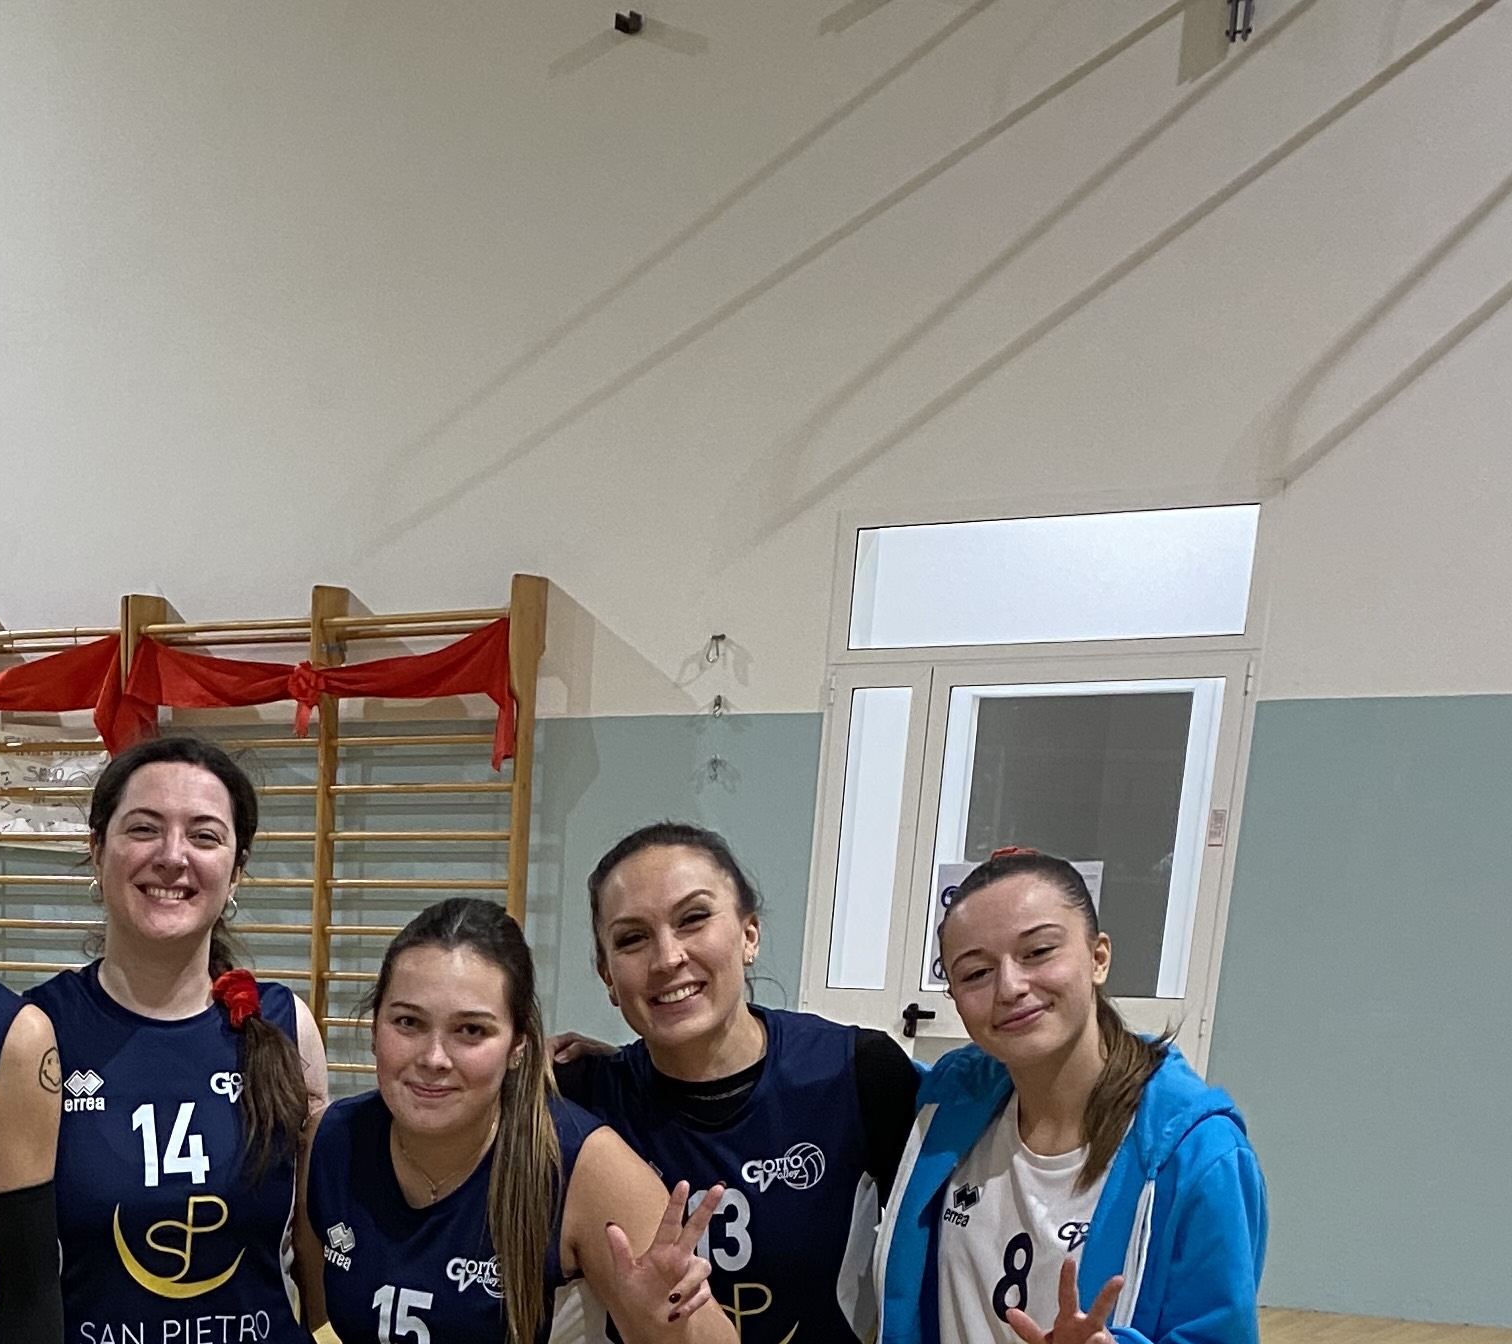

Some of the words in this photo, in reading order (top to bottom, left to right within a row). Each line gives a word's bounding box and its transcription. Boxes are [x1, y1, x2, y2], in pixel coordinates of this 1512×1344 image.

[64, 1096, 106, 1113] errea
[131, 1101, 211, 1187] 14
[943, 1207, 970, 1228] errea
[324, 1245, 352, 1271] errea
[992, 1232, 1034, 1324] 8
